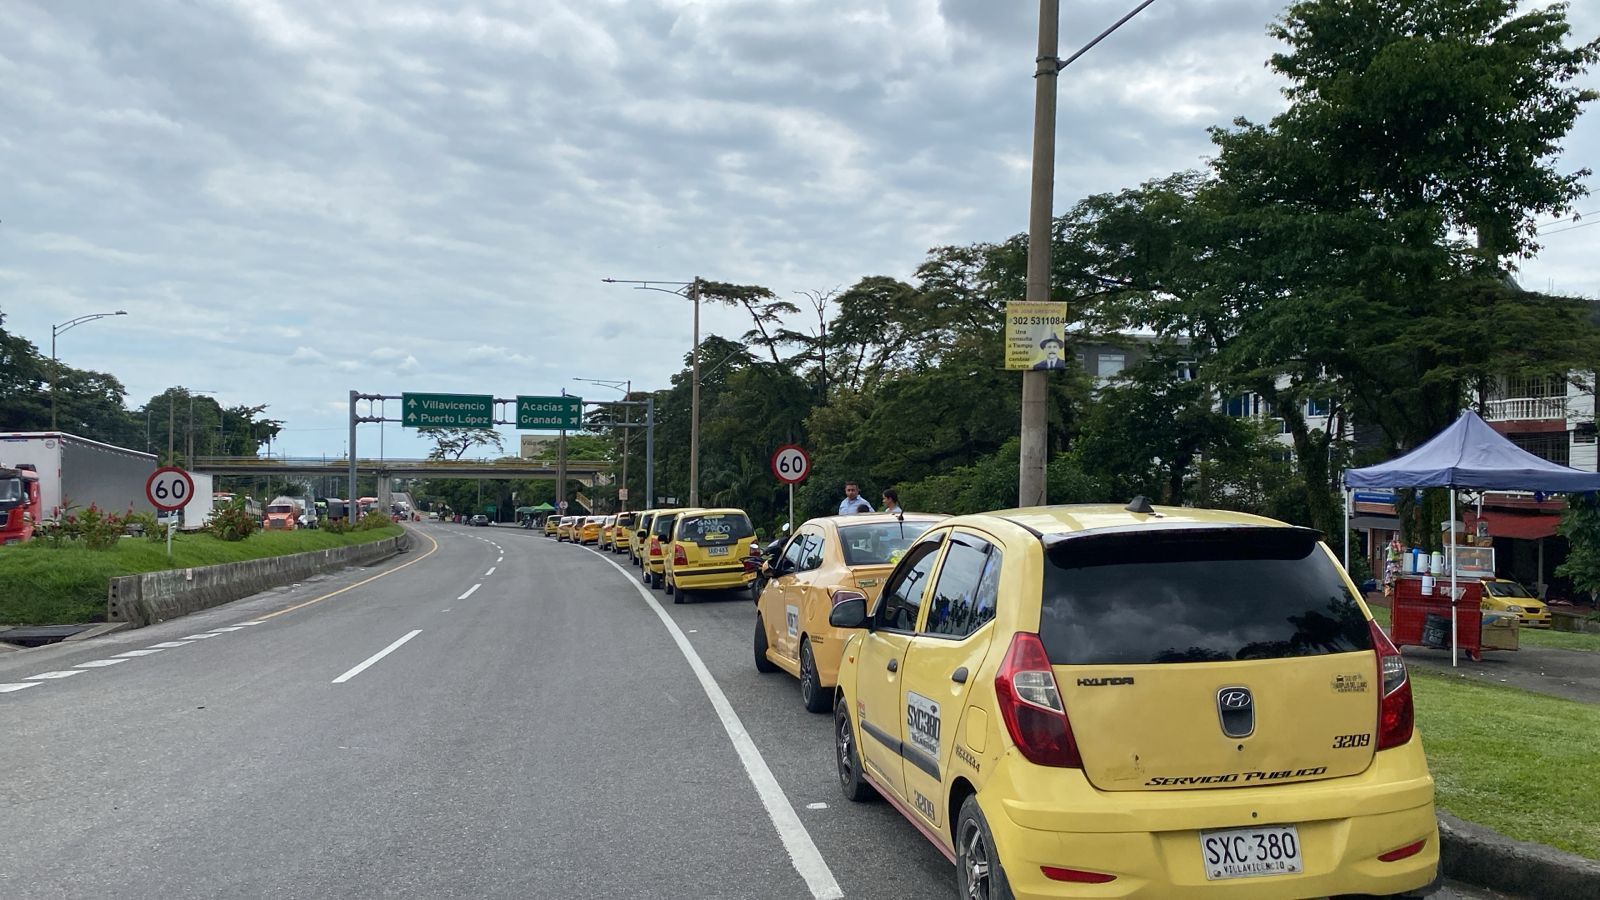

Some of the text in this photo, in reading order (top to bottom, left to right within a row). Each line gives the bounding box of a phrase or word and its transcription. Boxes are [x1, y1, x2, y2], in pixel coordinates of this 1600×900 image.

[1013, 316, 1065, 325] 302 5311084
[422, 400, 486, 411] Villavicencio
[521, 402, 564, 412] Acacías
[420, 413, 489, 426] Puerto López
[521, 415, 562, 425] Granada
[780, 455, 803, 473] 60
[156, 479, 185, 499] 60
[1077, 677, 1135, 687] HYUNDAI
[907, 704, 941, 742] SXC380
[1333, 733, 1371, 749] 3209
[1145, 767, 1328, 786] SERVICIO PUBLICO
[1206, 832, 1297, 865] SXC 380
[1223, 861, 1285, 875] VILLAVICENCIO
